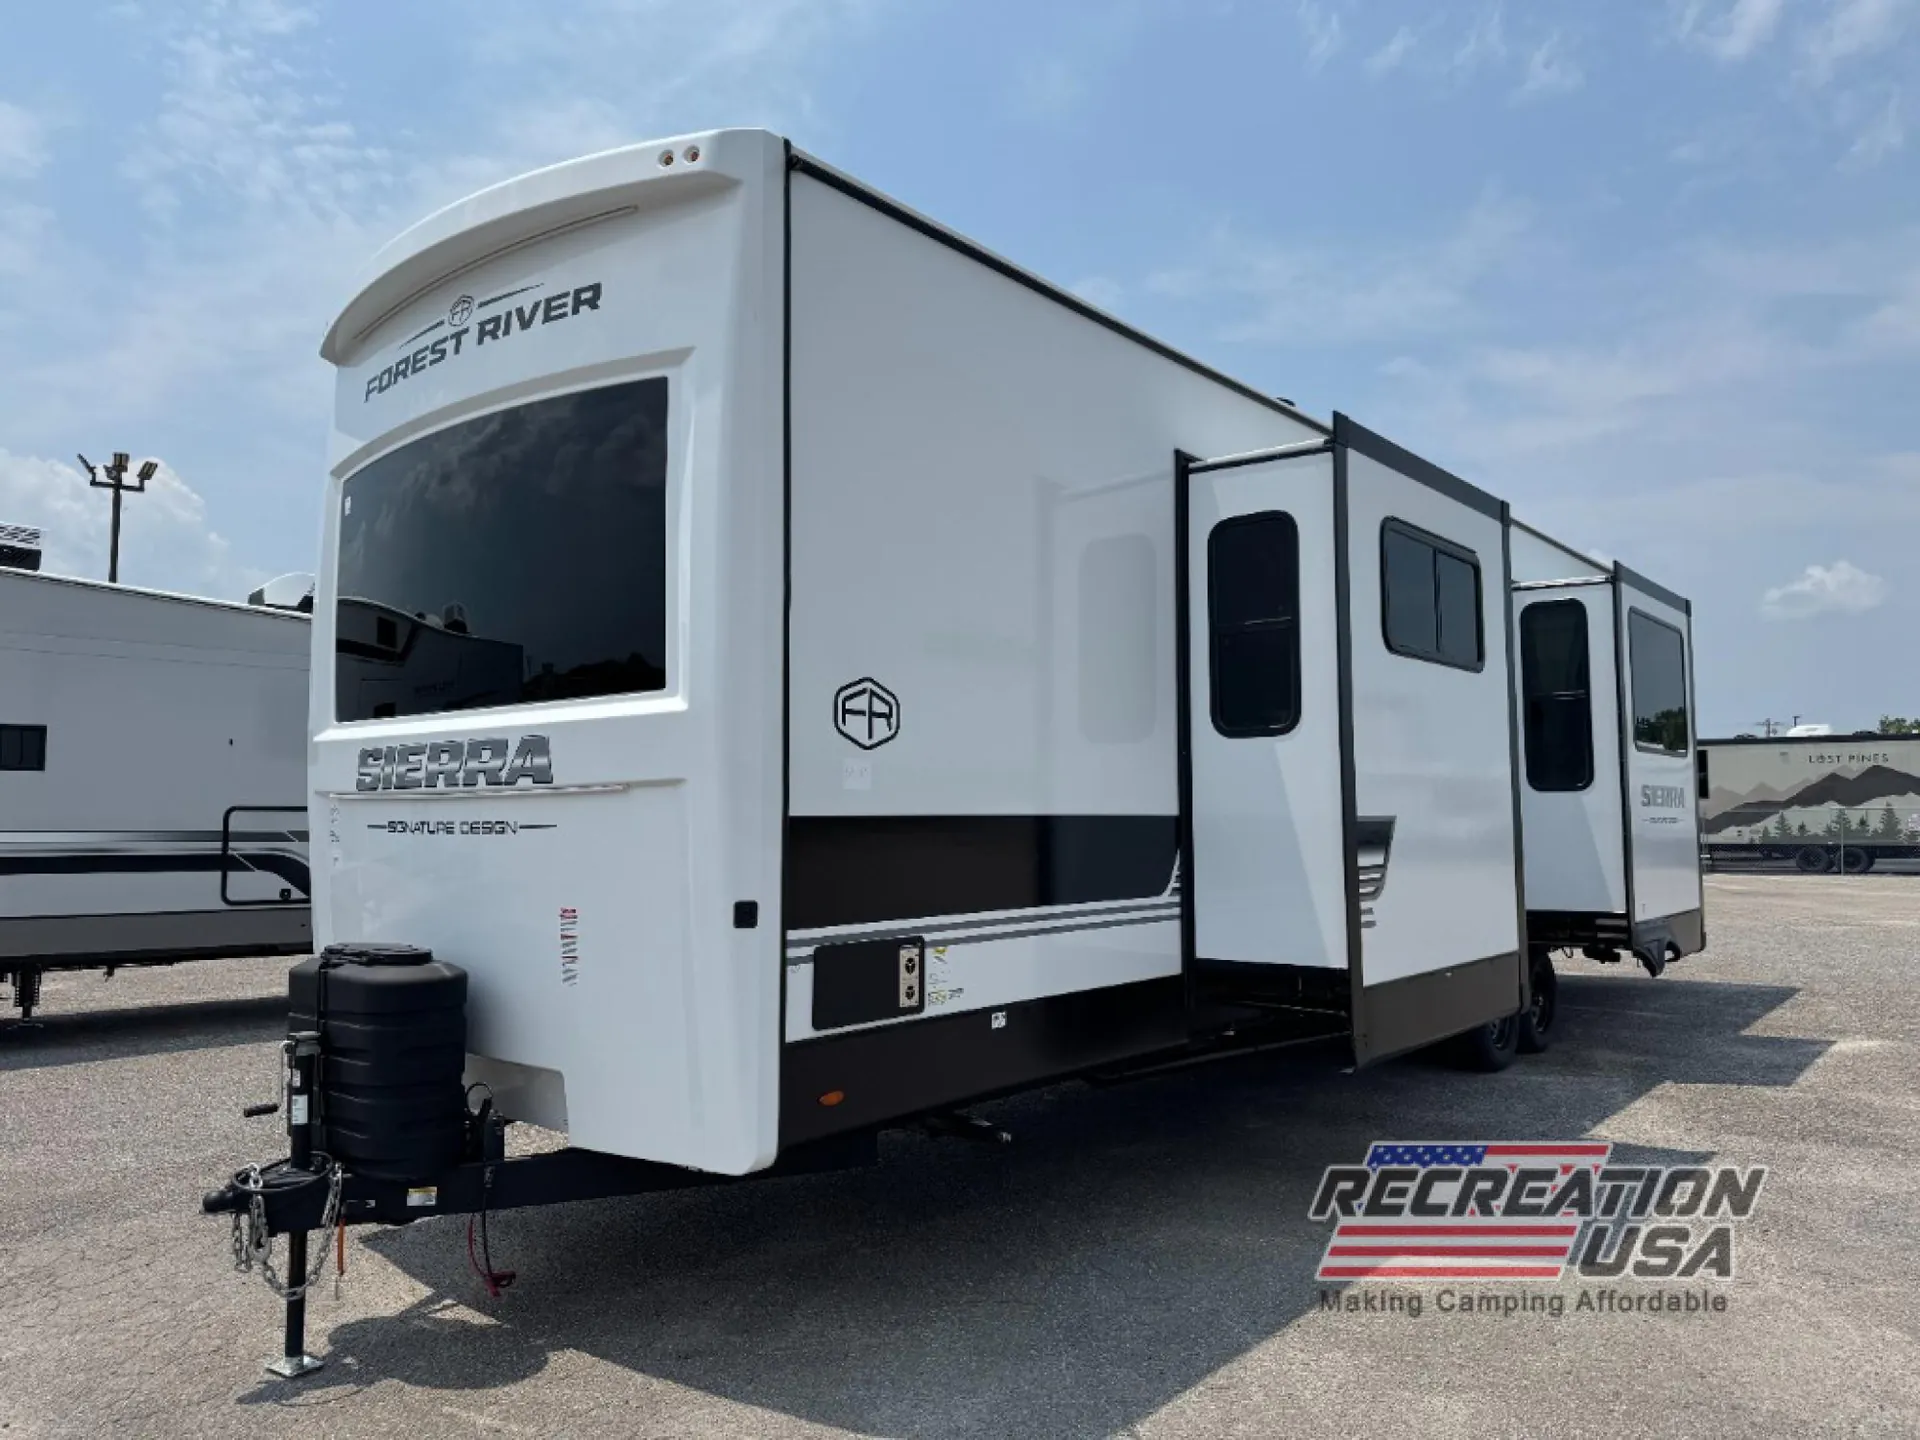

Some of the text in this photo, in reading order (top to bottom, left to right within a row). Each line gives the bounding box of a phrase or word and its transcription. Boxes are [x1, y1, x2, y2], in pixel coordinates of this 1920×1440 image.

[363, 282, 603, 403] FOREST RIVER
[356, 734, 553, 791] SIERRA
[1808, 752, 1889, 764] LOST PINES
[459, 820, 518, 835] DESIGN
